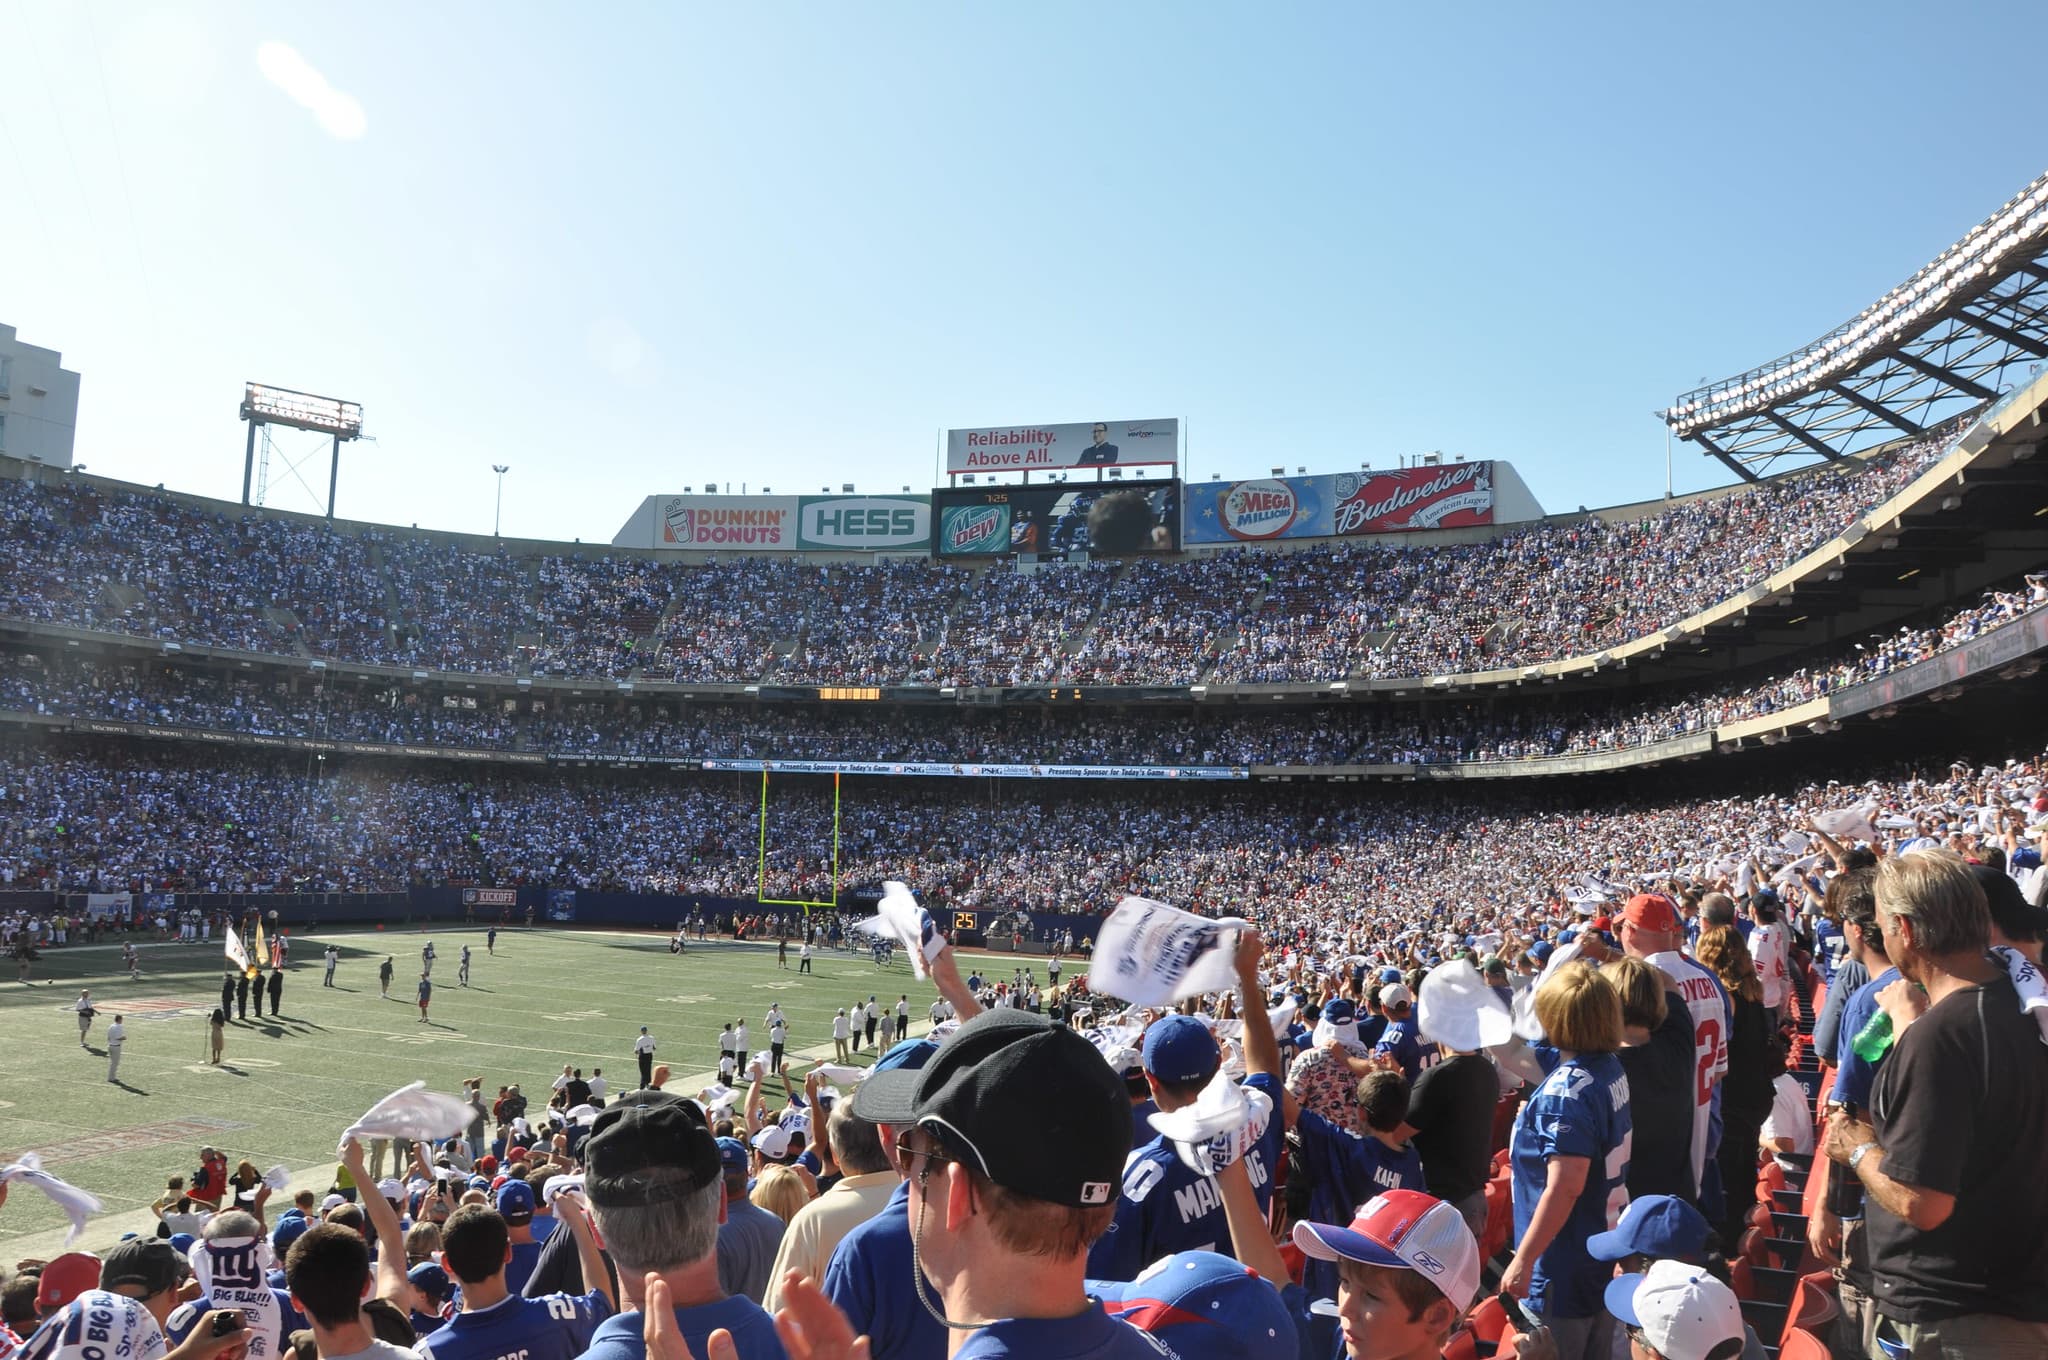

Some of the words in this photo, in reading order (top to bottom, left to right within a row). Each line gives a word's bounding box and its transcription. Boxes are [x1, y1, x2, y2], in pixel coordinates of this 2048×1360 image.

[968, 429, 1056, 446] Reliability.
[967, 450, 1020, 466] Above
[1025, 448, 1053, 463] All.
[1241, 492, 1290, 513] MEGA
[1336, 462, 1481, 534] Budweiser
[697, 509, 786, 526] DUNKIN'
[1237, 508, 1291, 527] MILLIONS
[1424, 500, 1462, 522] American
[1463, 494, 1488, 506] Lager
[817, 510, 915, 535] HESS
[696, 526, 781, 544] DONUTS
[480, 891, 513, 902] KICKOFF
[956, 914, 974, 928] 25
[1544, 1067, 1594, 1099] 27
[1374, 1166, 1402, 1189] KAHN
[213, 1289, 232, 1301] BIG
[87, 1310, 113, 1342] BIG
